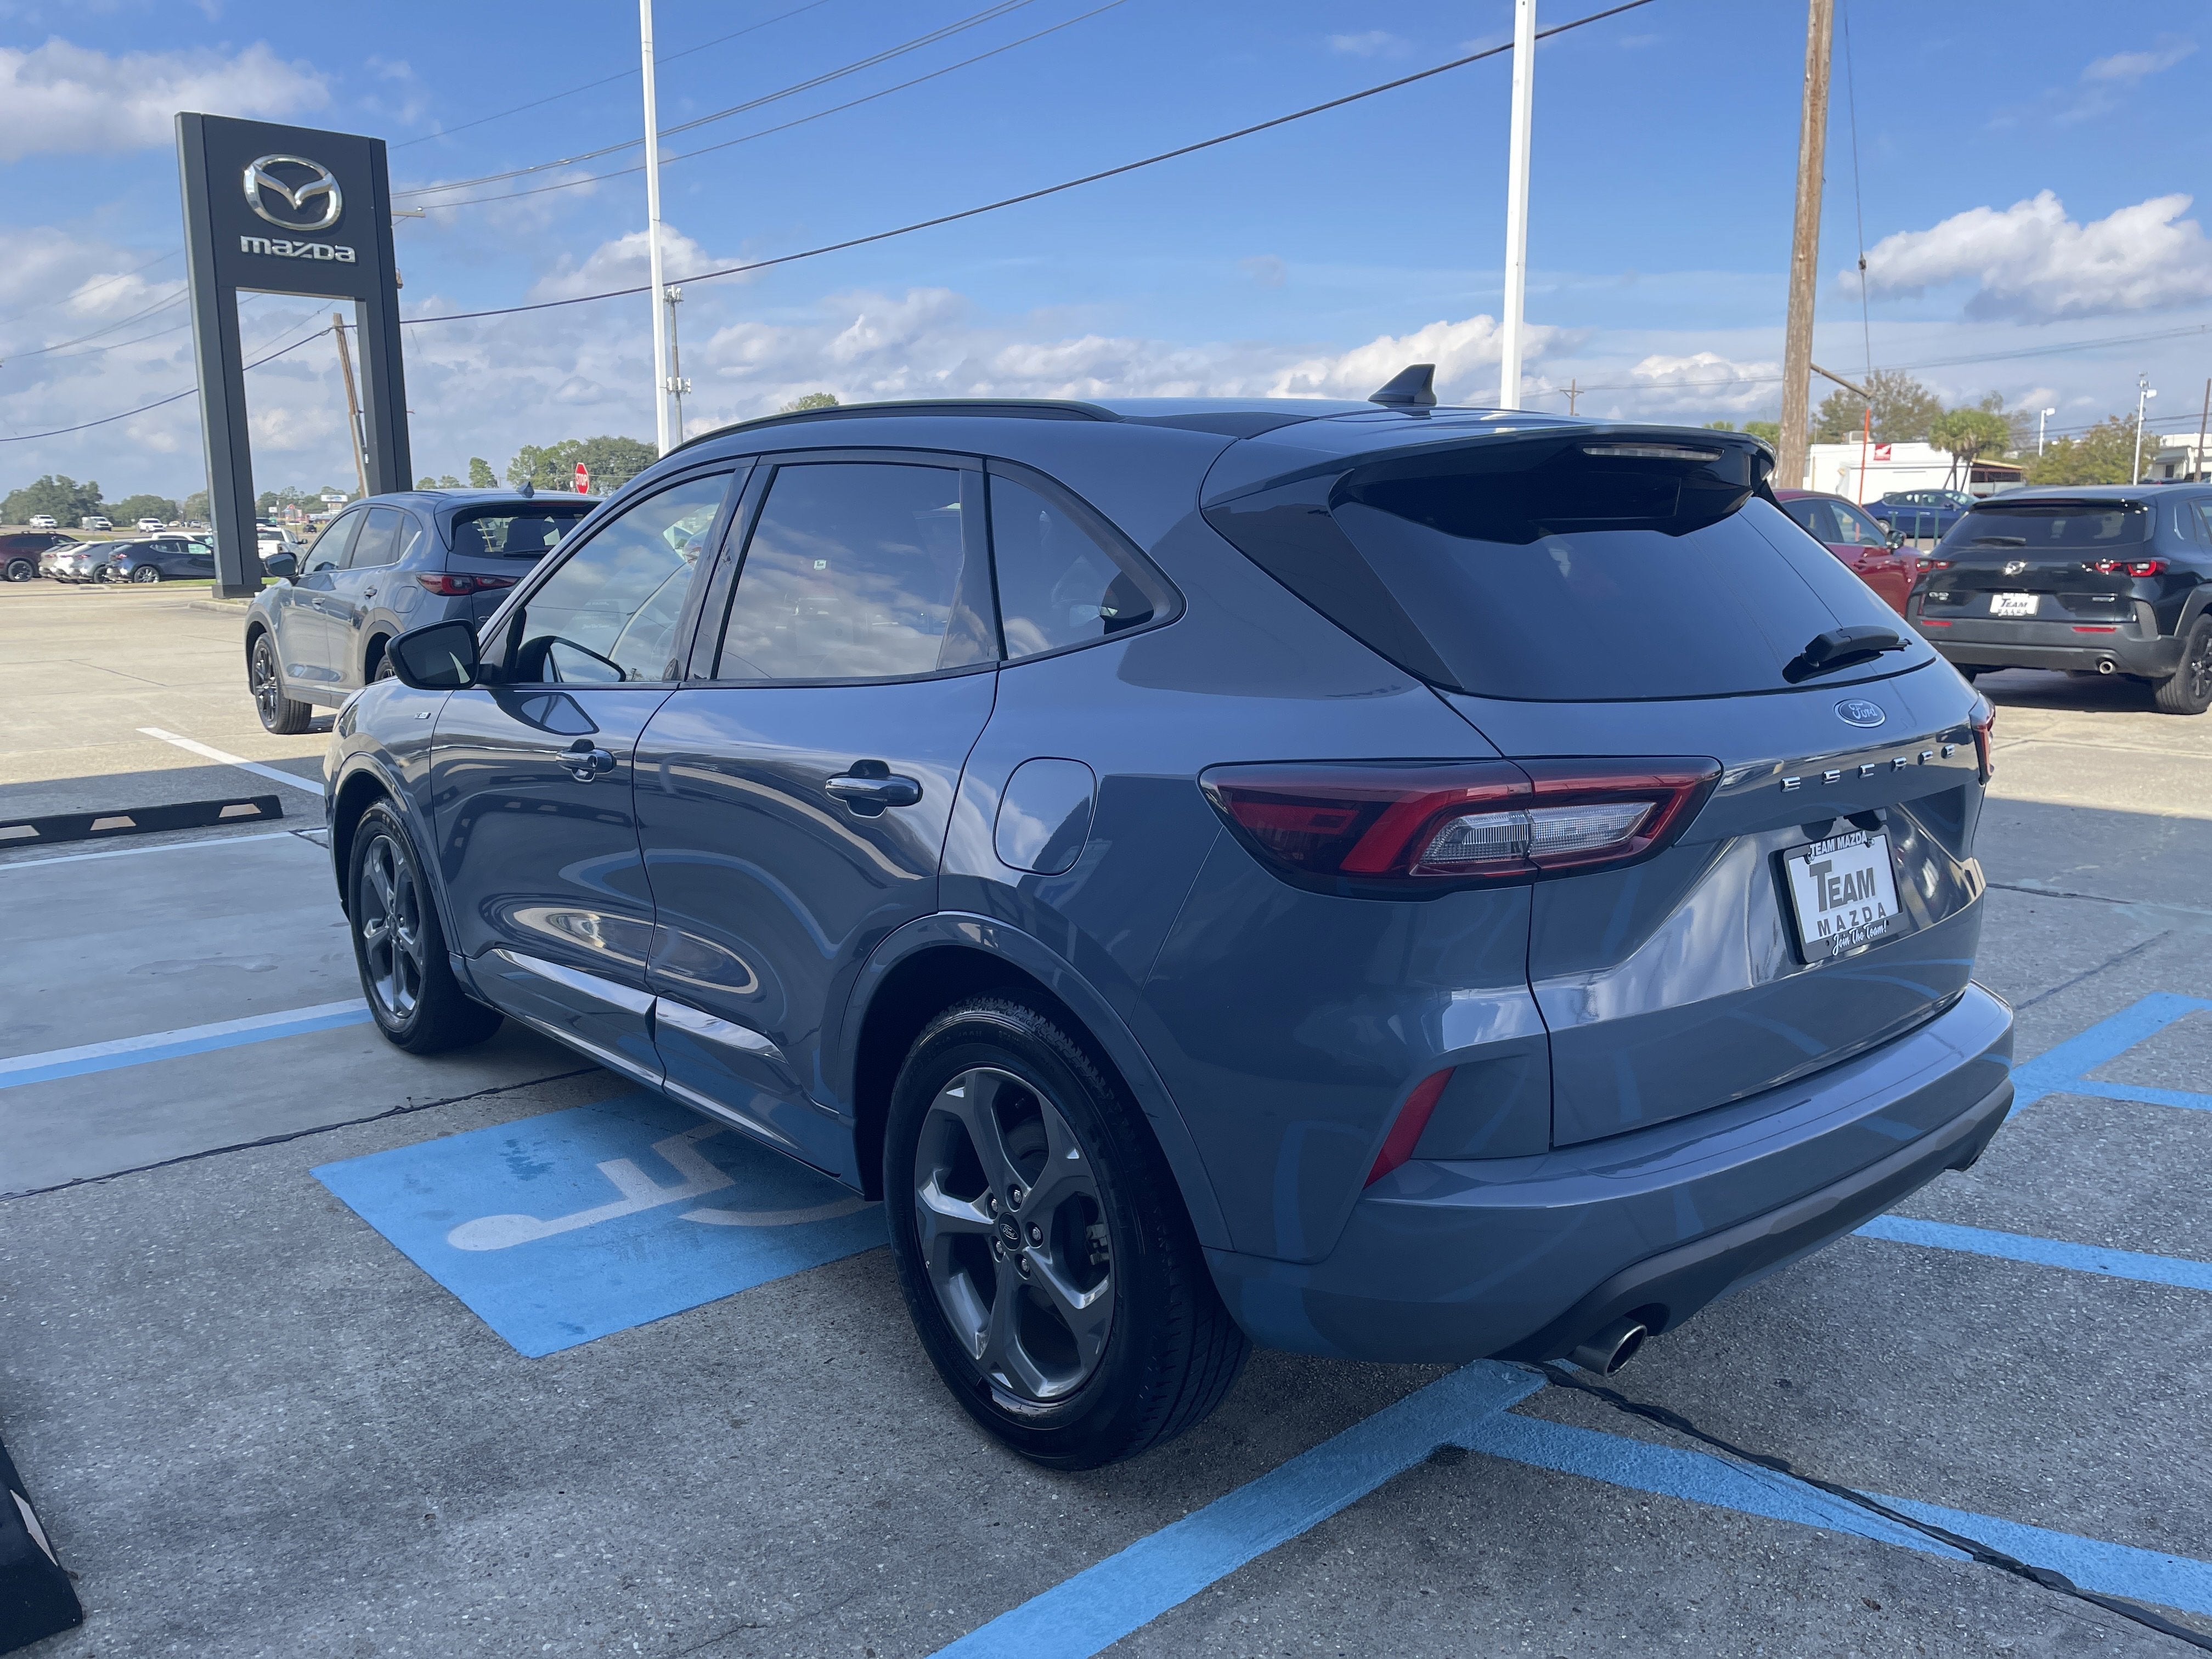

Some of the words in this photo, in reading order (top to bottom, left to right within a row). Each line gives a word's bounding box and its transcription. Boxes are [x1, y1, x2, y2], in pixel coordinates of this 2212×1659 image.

[575, 473, 588, 486] STOP
[1848, 702, 1877, 720] Ford
[1782, 744, 1955, 793] ESCAPE
[1809, 839, 1835, 856] TEAM
[1837, 831, 1867, 849] MAZDA
[1809, 860, 1876, 912] TEAM
[1817, 902, 1886, 937] MAZDA
[1832, 933, 1850, 956] Join
[1849, 927, 1864, 944] The
[1864, 919, 1887, 940] Team!
